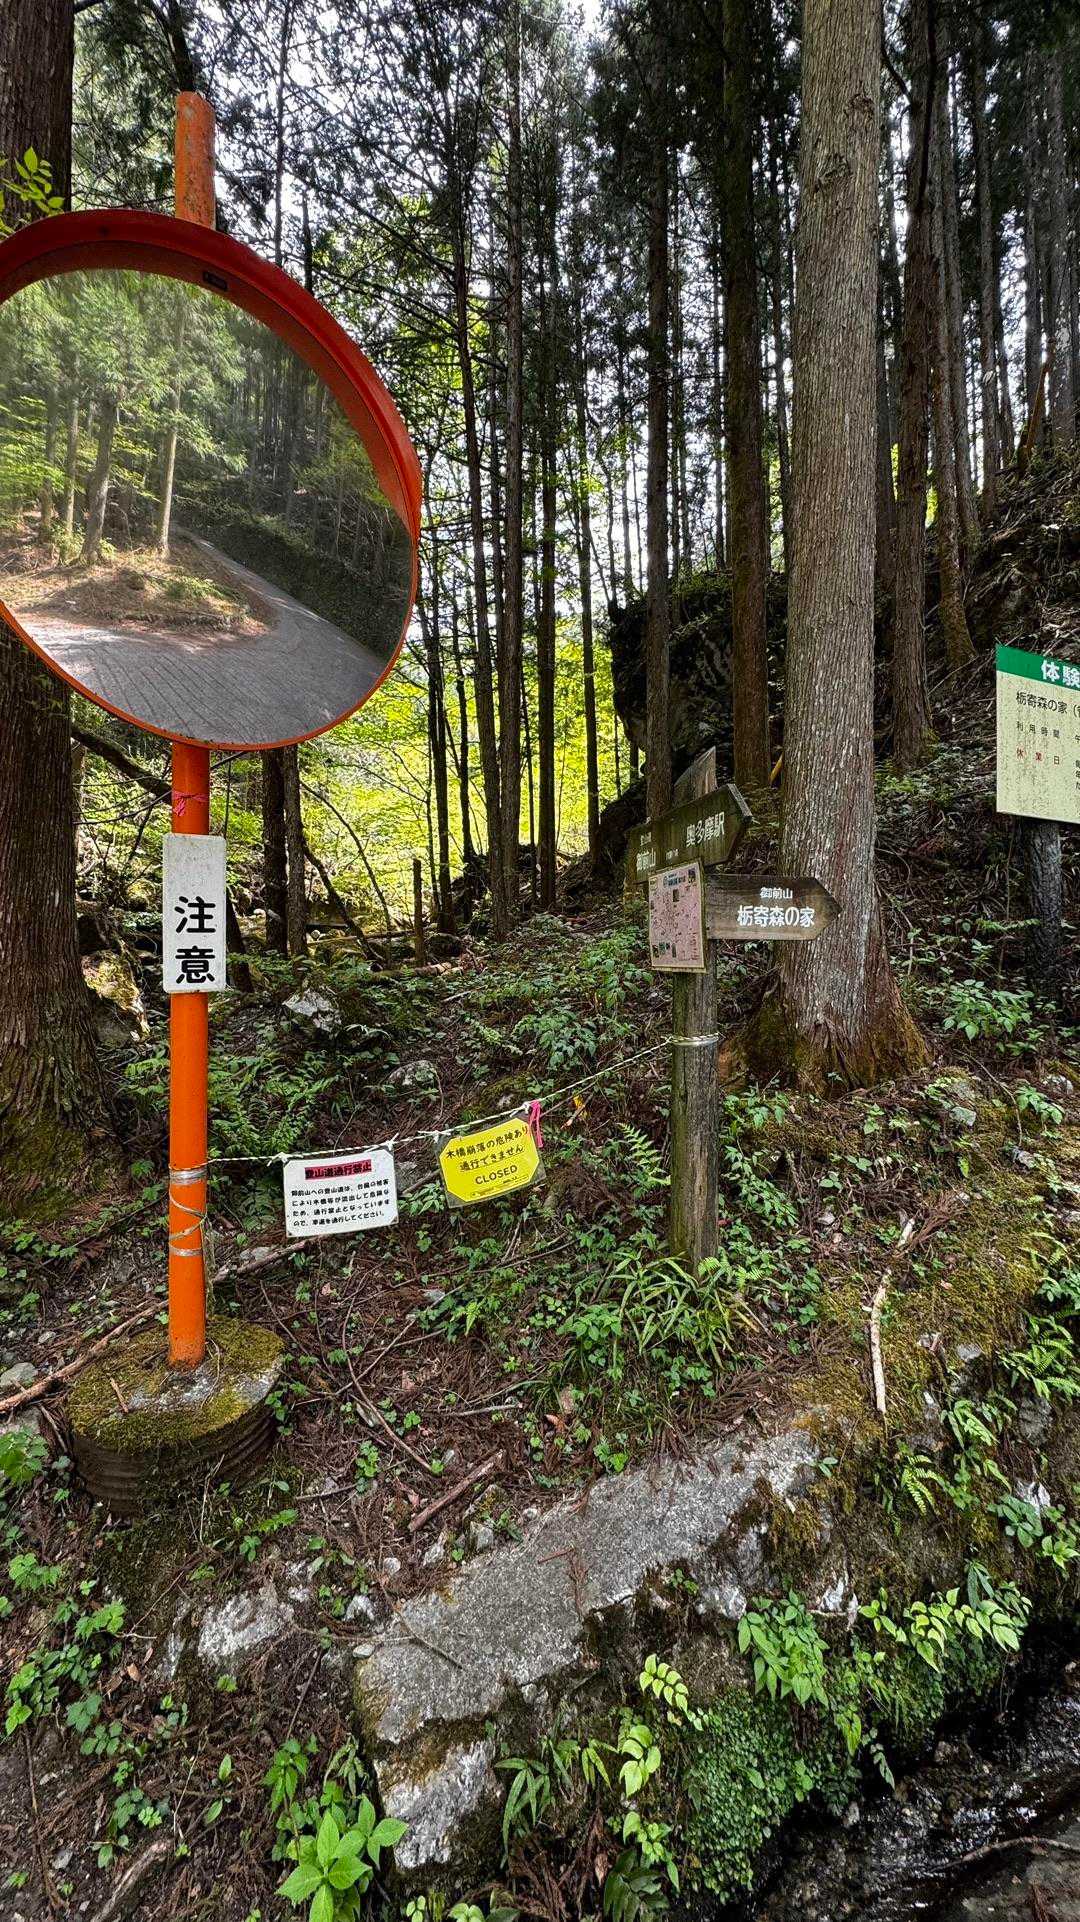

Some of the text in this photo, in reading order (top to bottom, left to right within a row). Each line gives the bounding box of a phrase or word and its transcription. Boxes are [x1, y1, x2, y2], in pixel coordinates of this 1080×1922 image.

[1016, 691, 1067, 714] 栃寄森の家
[686, 812, 725, 847] 奥多摩駅
[760, 886, 793, 899] 御前山
[737, 905, 815, 927] 栃寄森の家
[174, 896, 216, 984] 注意
[446, 1125, 528, 1158] 木橋崩落の危険あり
[460, 1145, 524, 1171] 通行できません
[306, 1161, 372, 1180] 登山道通行禁止
[475, 1165, 518, 1184] CLOSED
